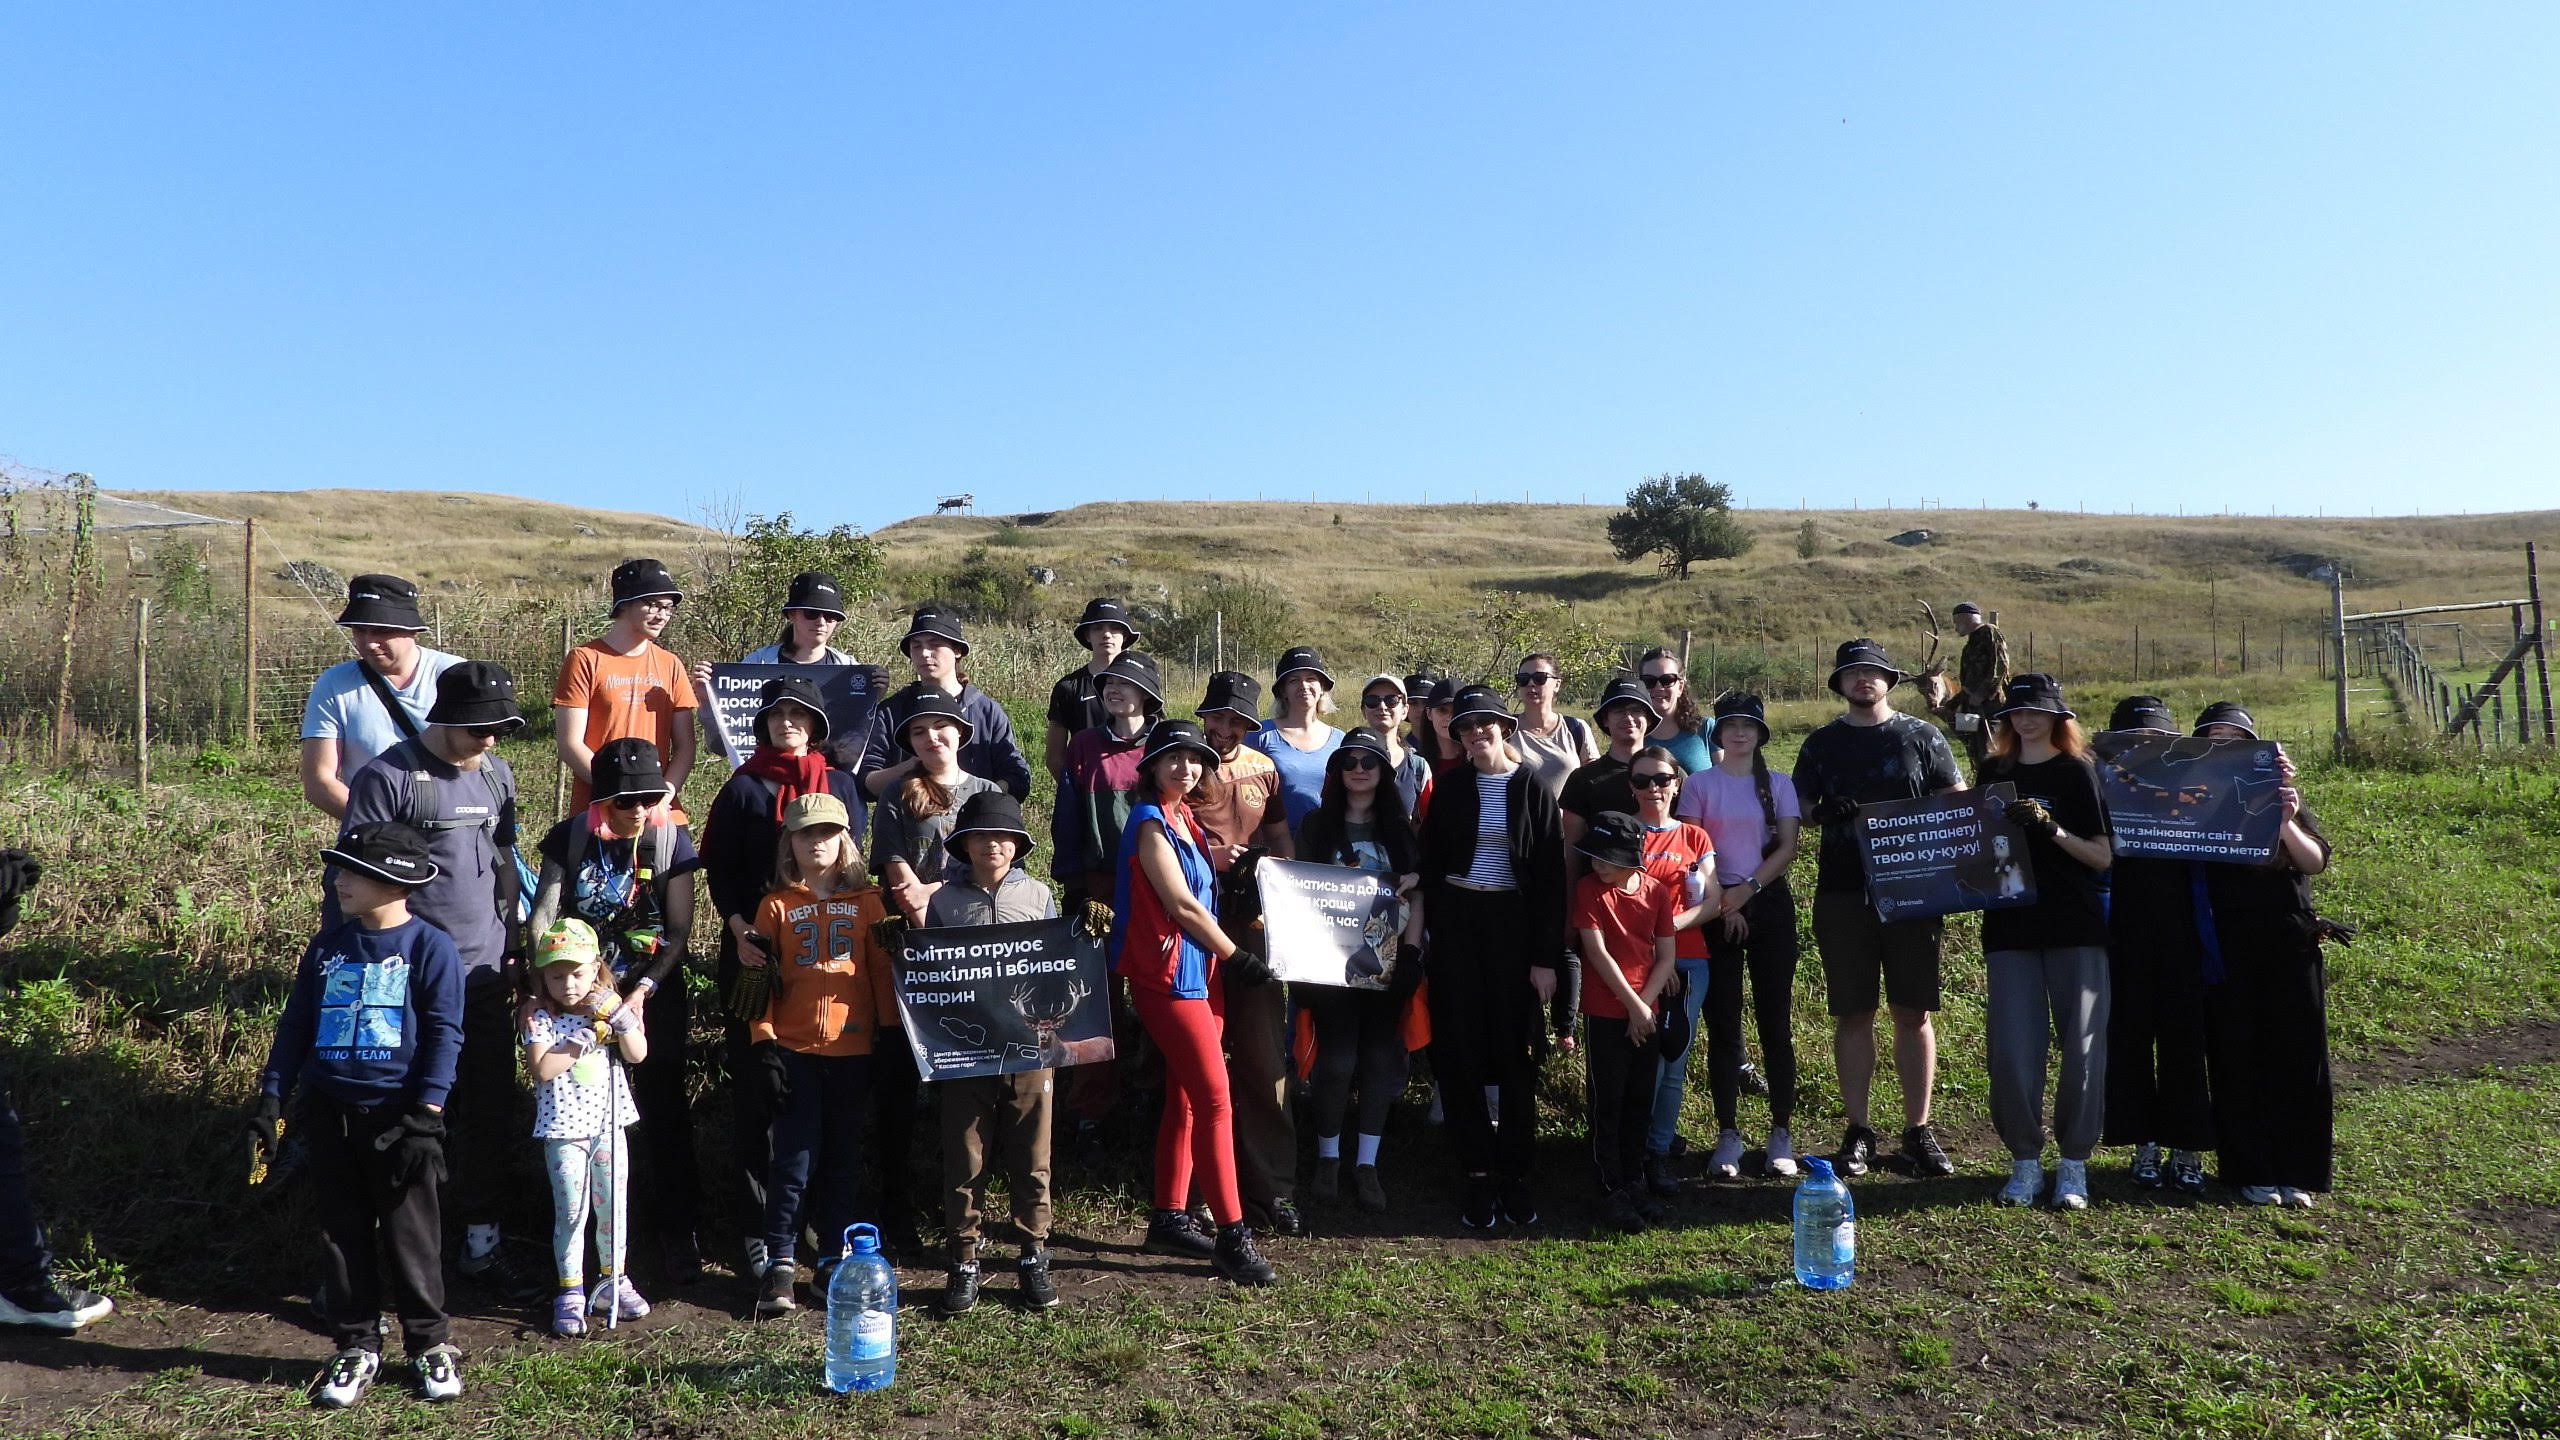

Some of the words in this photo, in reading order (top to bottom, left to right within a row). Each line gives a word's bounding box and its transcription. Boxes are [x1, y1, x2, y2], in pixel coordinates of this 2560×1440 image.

[728, 731, 757, 746] айв
[1867, 806, 1974, 830] Волонтерство
[1870, 833, 1916, 849] рятує
[1919, 823, 1976, 842] планету
[1977, 820, 1982, 833] і
[2113, 826, 2135, 835] чни
[2137, 827, 2205, 840] змінювати
[2208, 830, 2232, 842] світ
[2234, 833, 2243, 841] з
[1872, 851, 1915, 865] твою
[1918, 840, 1981, 862] ку-ку-ху!
[2119, 840, 2141, 849] ого
[2143, 841, 2227, 854] квадратного
[2230, 846, 2270, 857] метра
[1340, 883, 1354, 894] за
[1356, 885, 1392, 897] долю
[787, 903, 818, 922] DEPT
[826, 902, 859, 917] ISSUE
[1314, 897, 1356, 911] краще
[1337, 917, 1359, 928] час
[794, 919, 853, 966] 36
[903, 945, 966, 962] Сміття
[970, 939, 1044, 959] отруює
[904, 966, 992, 985] довкілля
[996, 961, 1001, 977] і
[1006, 957, 1077, 976] вбиває
[905, 990, 976, 1006] тварин
[320, 1050, 349, 1060] DINO
[355, 1050, 392, 1060] TEAM
